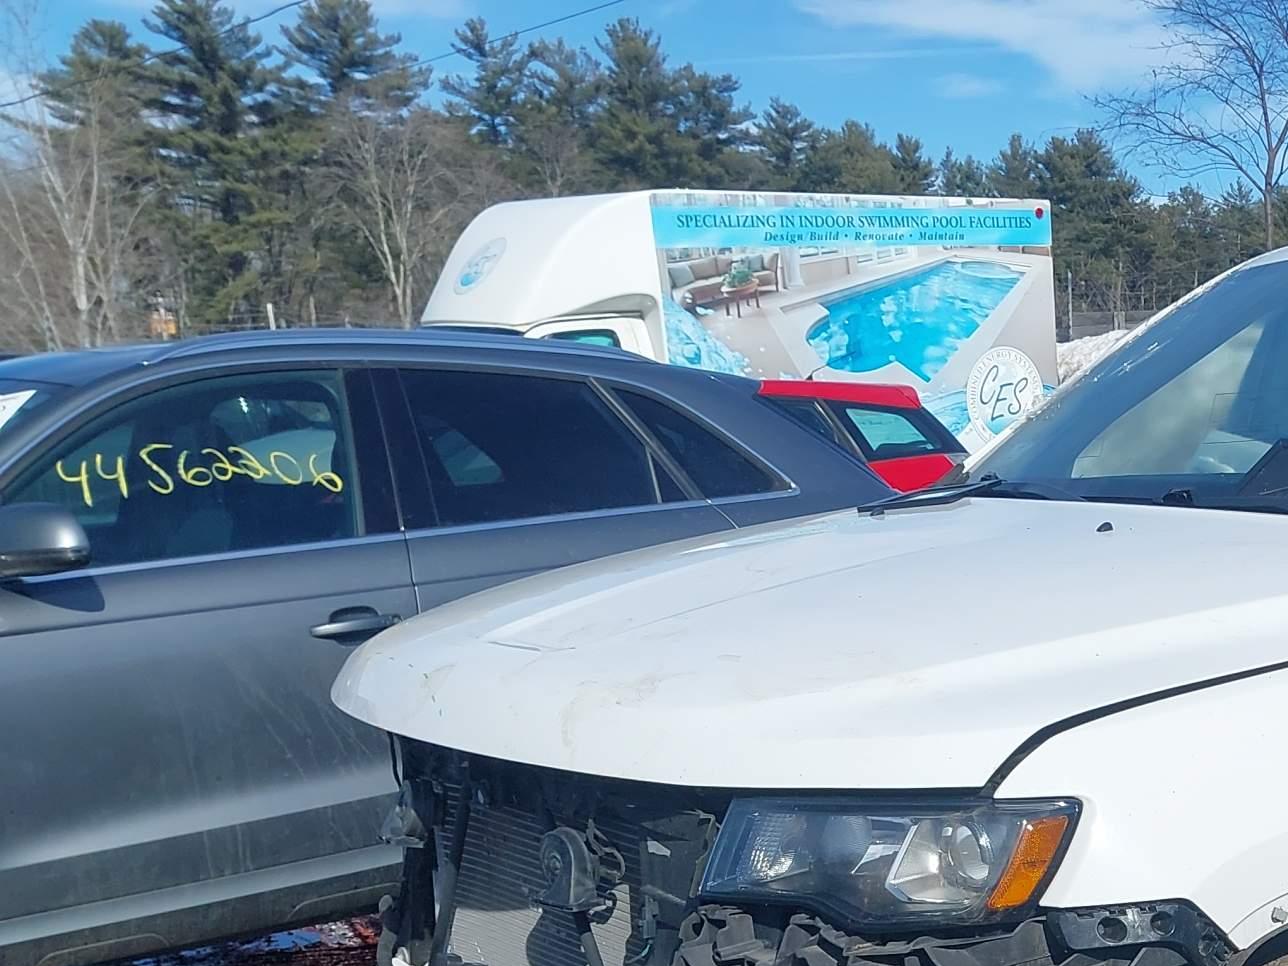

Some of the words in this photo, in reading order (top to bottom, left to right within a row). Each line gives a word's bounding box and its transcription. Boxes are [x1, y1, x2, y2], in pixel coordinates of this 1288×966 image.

[676, 214, 777, 229] SPECIALIZING
[780, 214, 796, 229] IN
[800, 215, 856, 229] INDOOR
[858, 215, 929, 229] SWIMMING
[932, 215, 967, 229] POOL
[969, 216, 1032, 229] FACILITIES
[854, 231, 905, 242] Renovate
[918, 231, 966, 242] Maintain
[979, 364, 1029, 421] CES
[55, 442, 344, 507] 44562206
